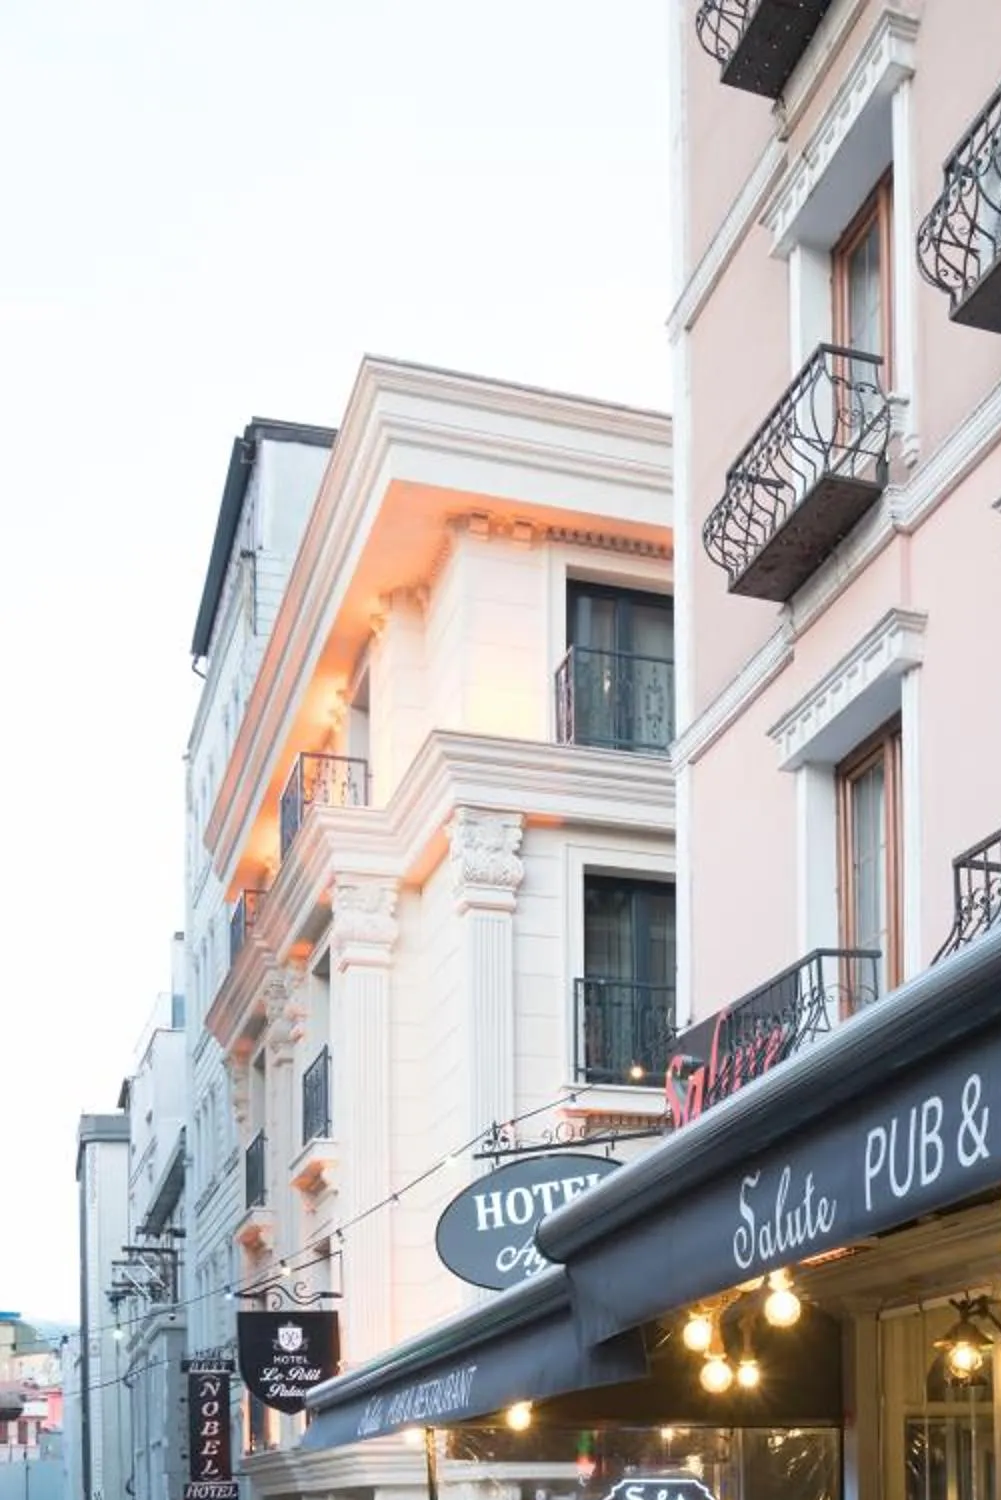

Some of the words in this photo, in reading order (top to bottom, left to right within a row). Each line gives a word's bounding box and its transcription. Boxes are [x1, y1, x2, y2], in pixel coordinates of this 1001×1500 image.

[733, 1165, 837, 1269] Salute
[865, 1096, 944, 1211] PUB
[957, 1075, 990, 1167] &
[273, 1355, 308, 1365] HOTEL
[260, 1367, 285, 1381] Le
[200, 1381, 221, 1476] NOBEL
[186, 1485, 237, 1500] HOTEL
